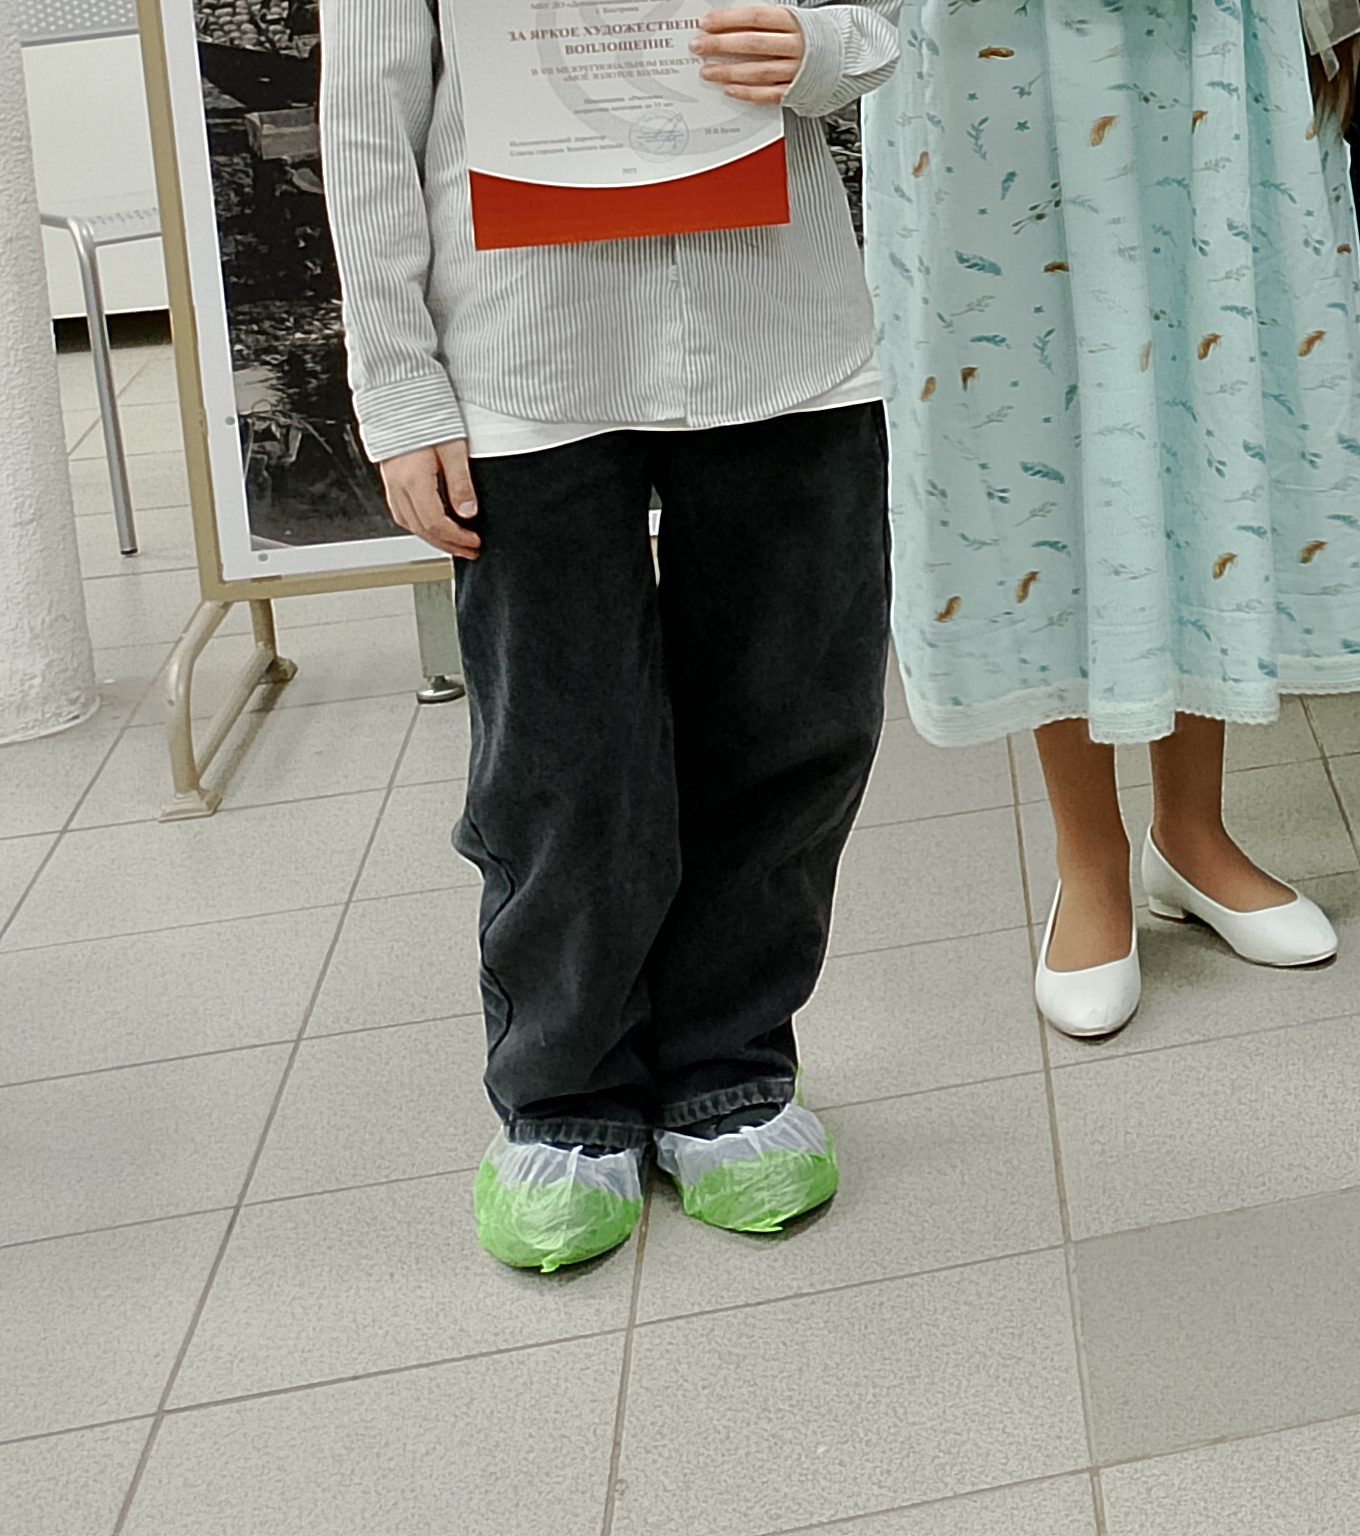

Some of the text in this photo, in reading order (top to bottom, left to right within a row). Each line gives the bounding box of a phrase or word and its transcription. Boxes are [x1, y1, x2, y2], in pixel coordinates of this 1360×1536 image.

[508, 18, 701, 42] ЗА ЯРКОЕ ХУДОЖЕСТВЕН
[565, 38, 674, 55] ВОПЛОЩЕНИЕ
[659, 57, 708, 68] КОНКУРС
